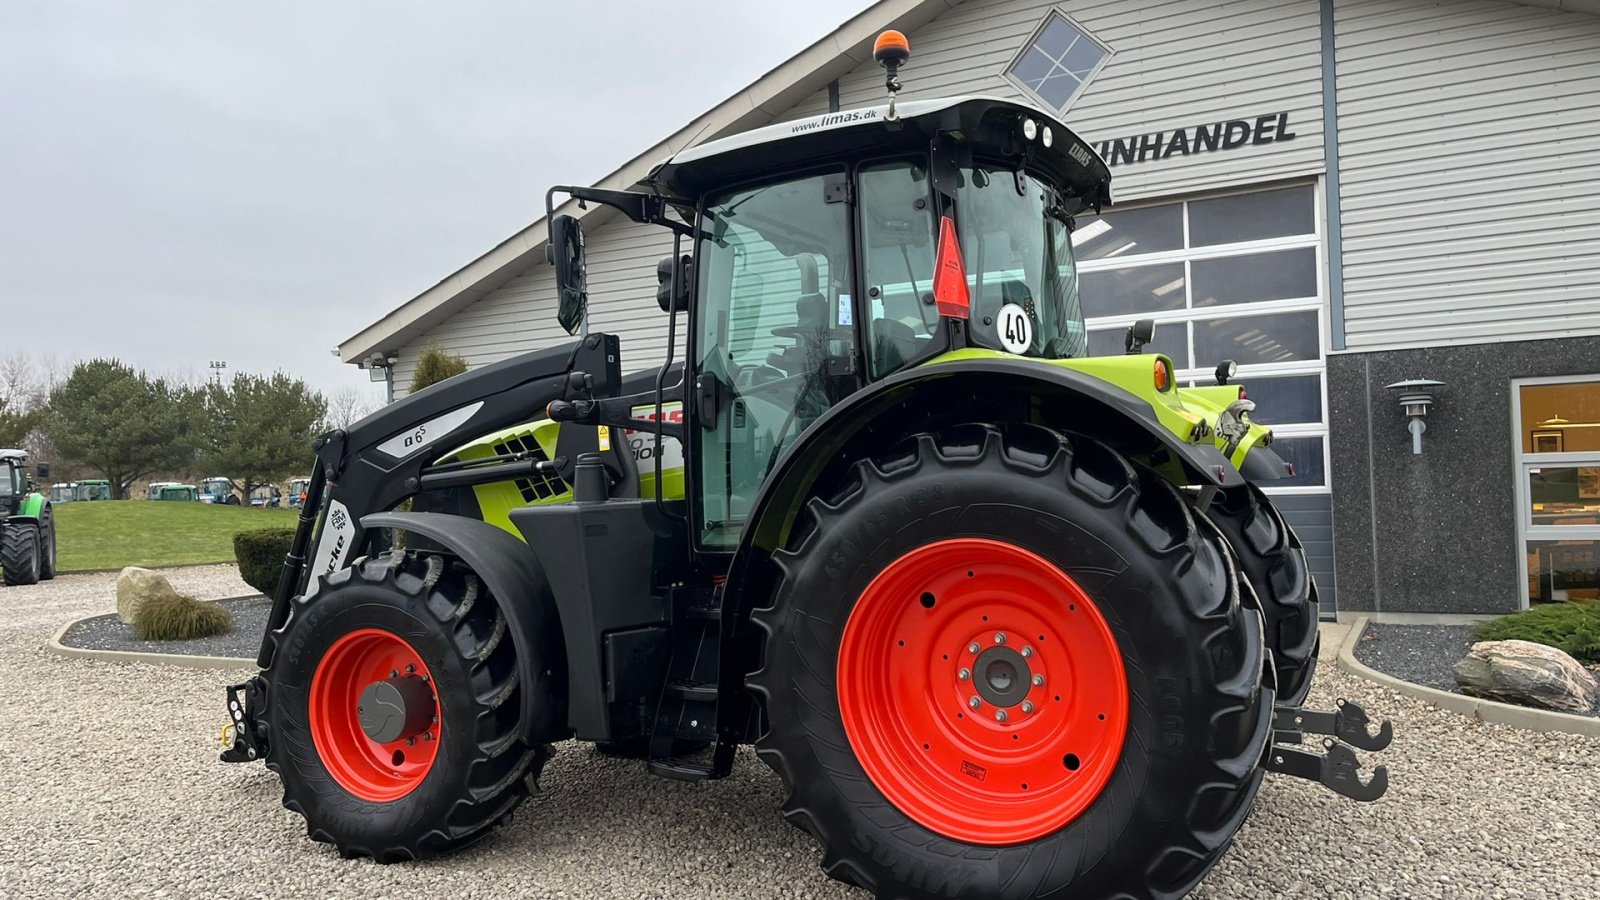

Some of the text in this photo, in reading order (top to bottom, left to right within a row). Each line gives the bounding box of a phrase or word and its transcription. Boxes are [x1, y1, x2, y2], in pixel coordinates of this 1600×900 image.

[791, 110, 877, 133] www.limas.dk
[1068, 142, 1092, 168] CLAAS
[1090, 112, 1296, 167] INHANDEL
[1005, 313, 1026, 345] 40
[327, 535, 345, 573] cke
